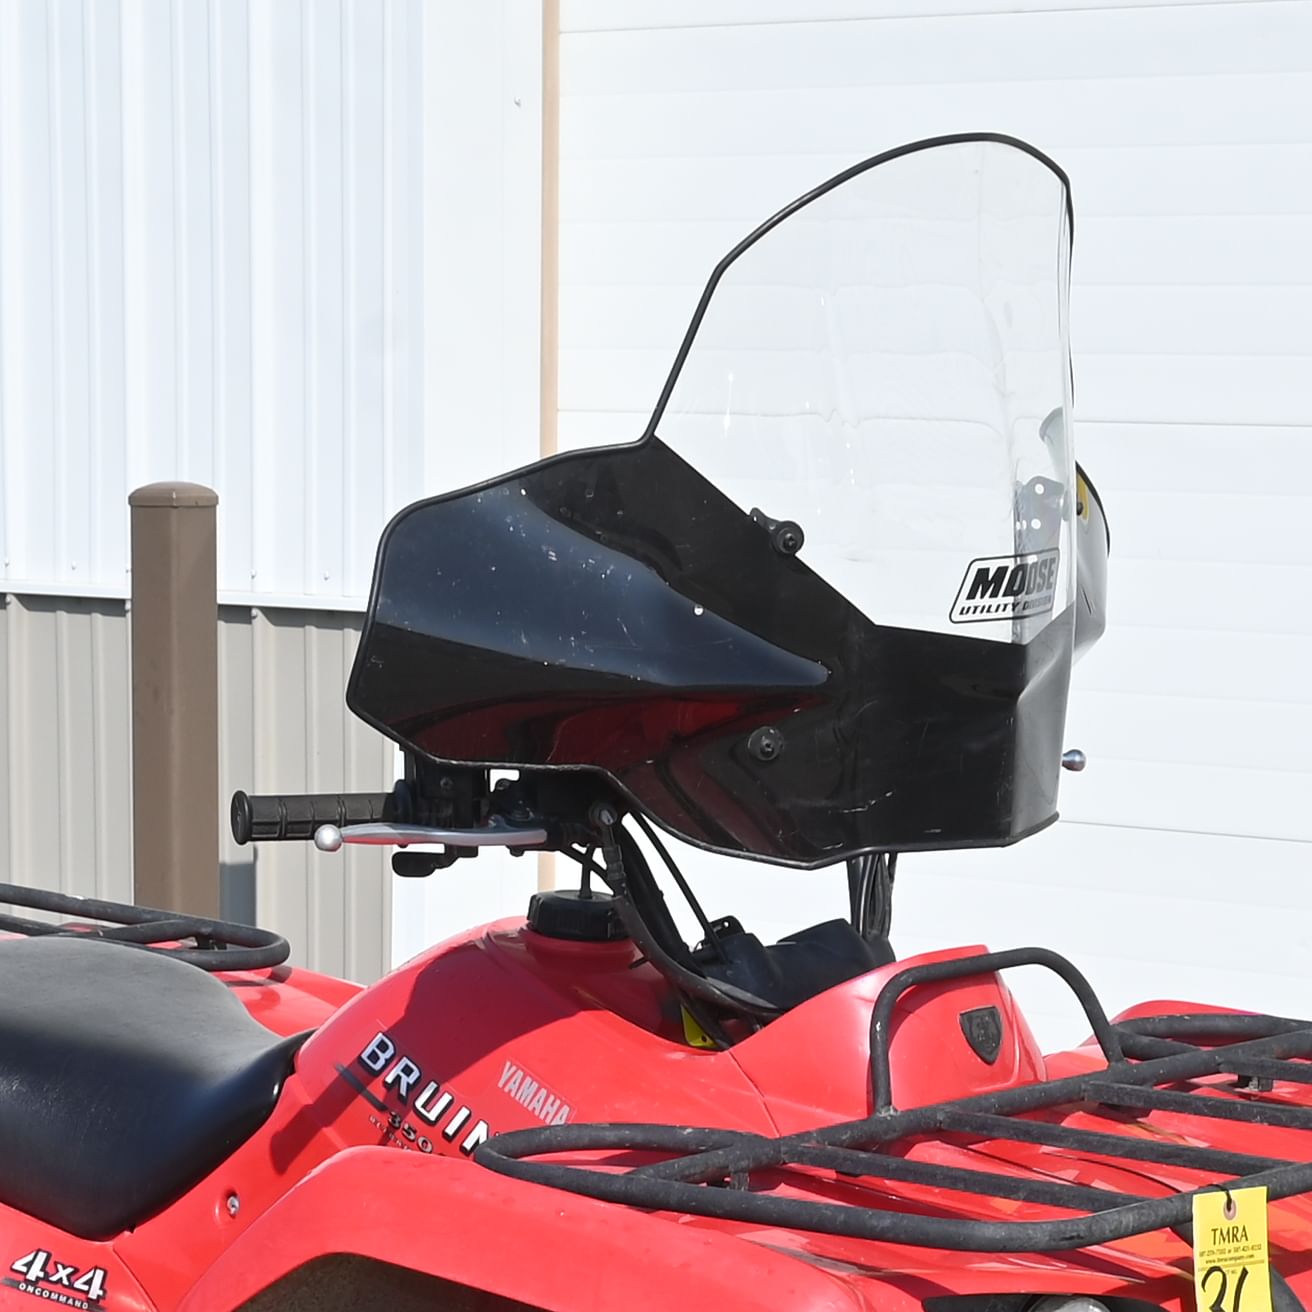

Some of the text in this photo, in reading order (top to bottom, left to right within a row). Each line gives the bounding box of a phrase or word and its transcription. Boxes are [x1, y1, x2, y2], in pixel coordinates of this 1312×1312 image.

[966, 557, 1057, 601] MOOSE
[959, 602, 1021, 616] UTILITY
[497, 1060, 572, 1126] YAMAHA
[387, 1111, 433, 1154] 350
[1210, 1224, 1249, 1246] TMRA
[10, 1248, 108, 1304] 4x4
[18, 1282, 89, 1310] ONCOMMAND
